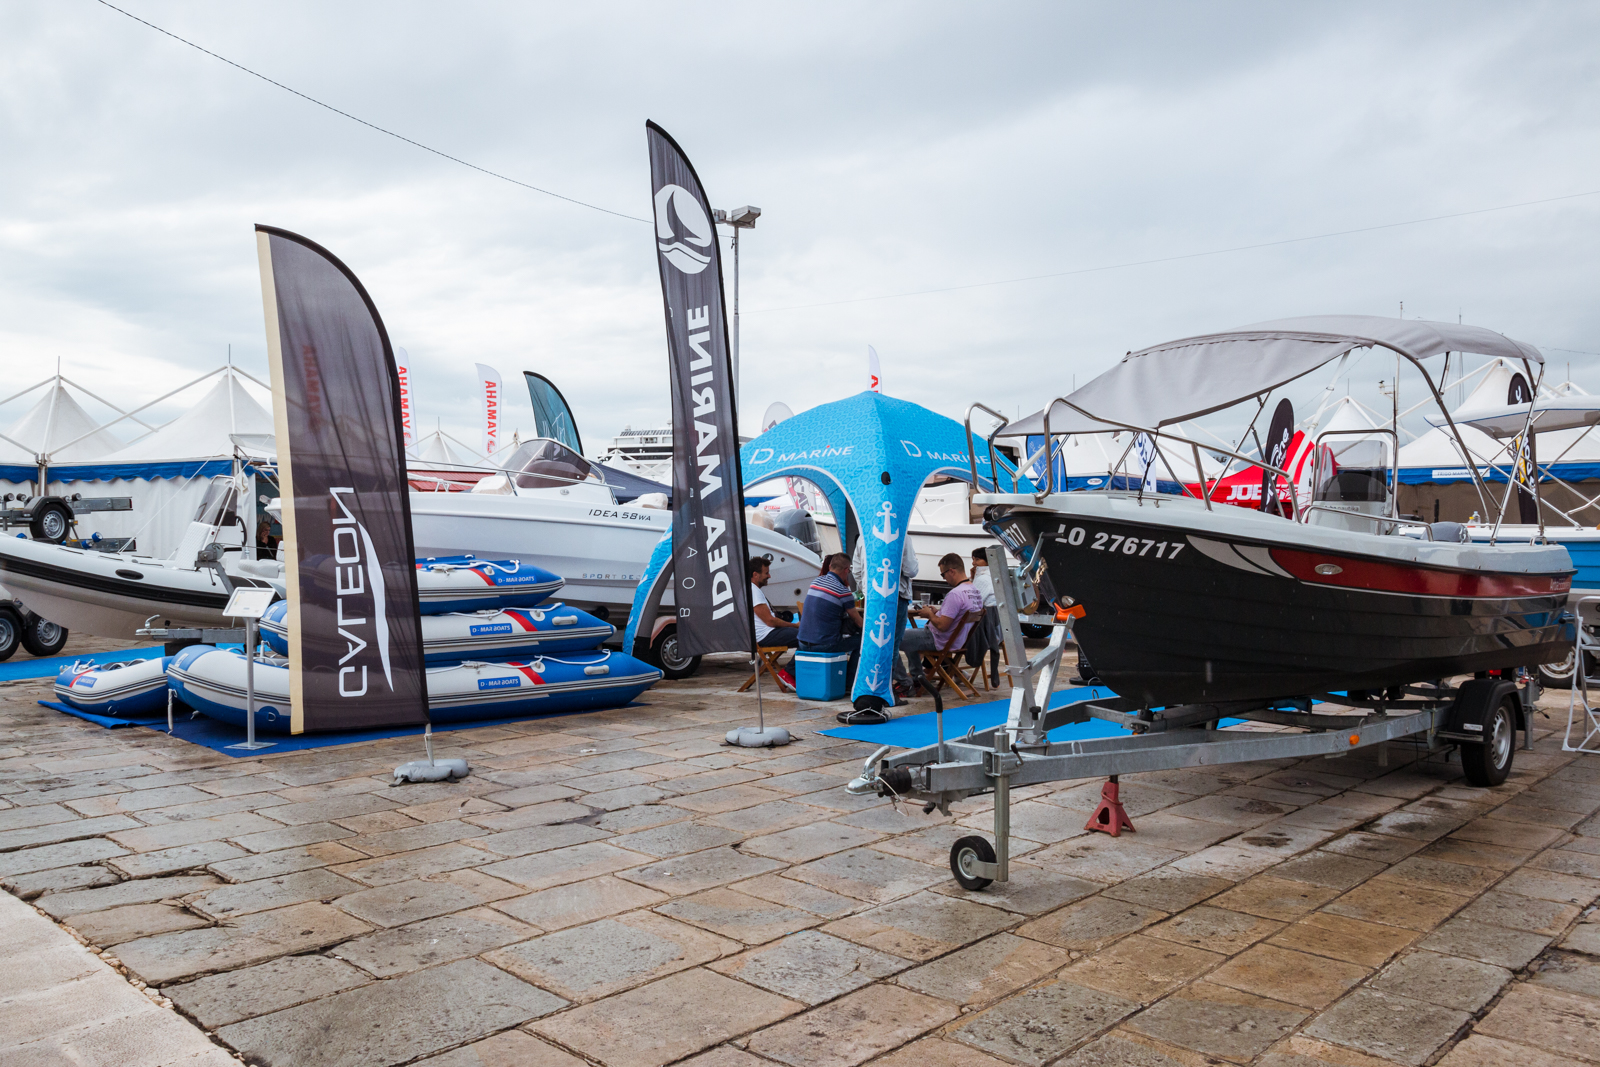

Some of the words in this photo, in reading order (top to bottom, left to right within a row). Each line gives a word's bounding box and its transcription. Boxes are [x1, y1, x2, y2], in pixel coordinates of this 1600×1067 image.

[777, 445, 855, 463] MARINE
[588, 508, 618, 519] IDEA
[1054, 523, 1086, 546] LO
[1090, 532, 1186, 560] 276717
